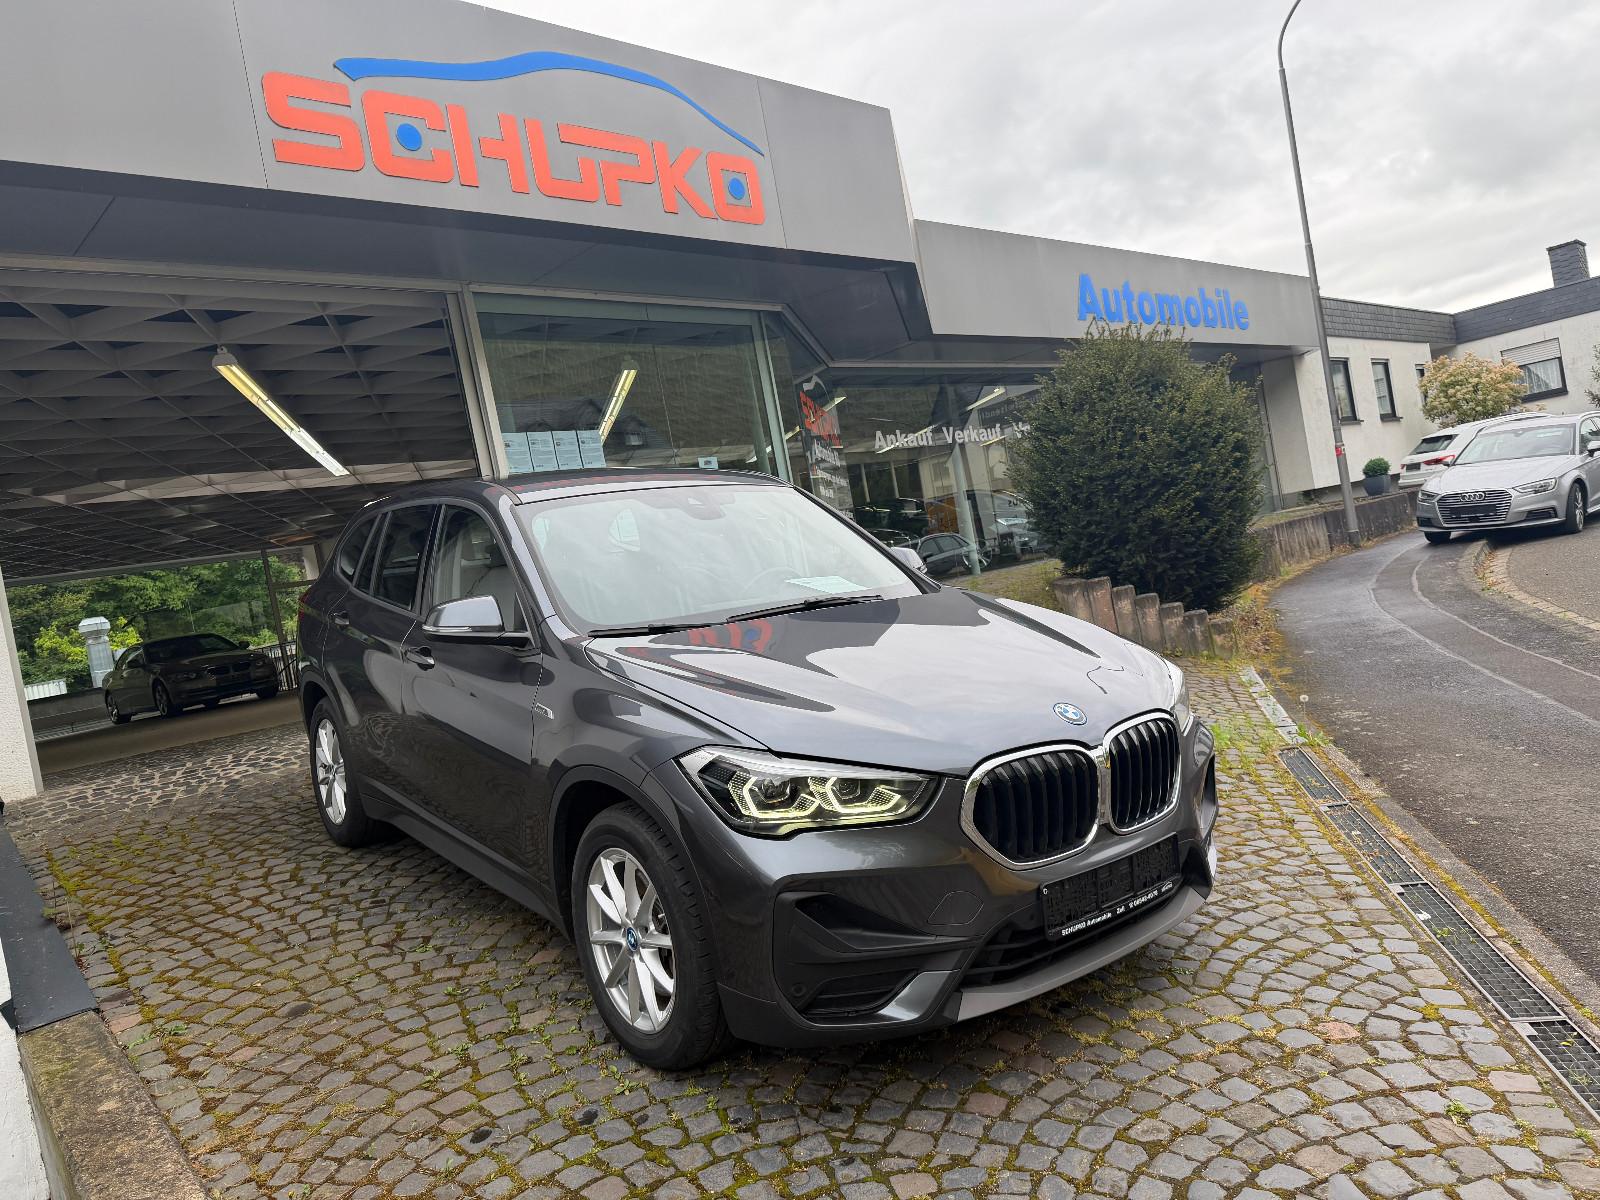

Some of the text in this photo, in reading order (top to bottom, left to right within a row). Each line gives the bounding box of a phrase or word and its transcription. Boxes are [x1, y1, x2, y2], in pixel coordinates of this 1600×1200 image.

[262, 71, 765, 225] SCHUPKO
[1078, 272, 1250, 331] Automobile
[875, 427, 933, 449] Ankauf
[942, 424, 1001, 444] Verkauf
